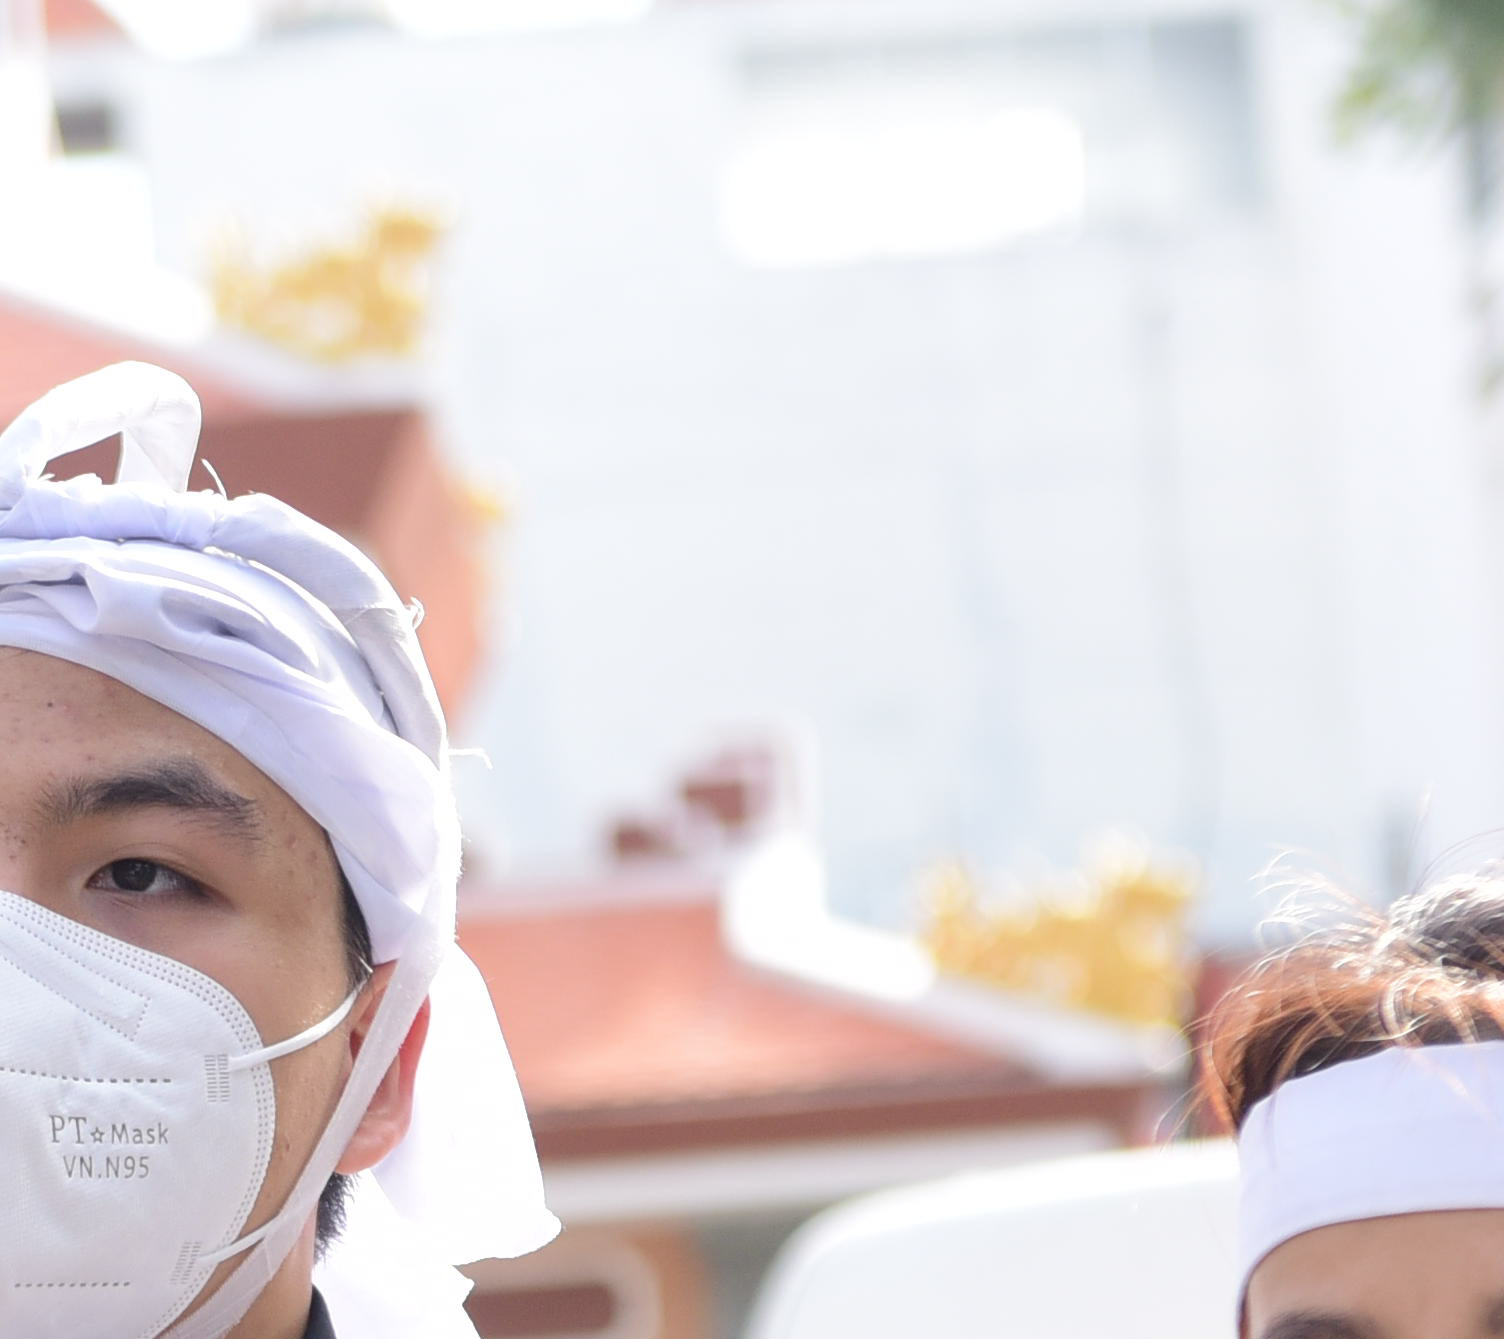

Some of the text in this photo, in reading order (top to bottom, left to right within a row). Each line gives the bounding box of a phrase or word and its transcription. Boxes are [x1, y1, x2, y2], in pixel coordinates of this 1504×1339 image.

[49, 1115, 168, 1145] PT Mask
[63, 1156, 150, 1179] VN.N95
